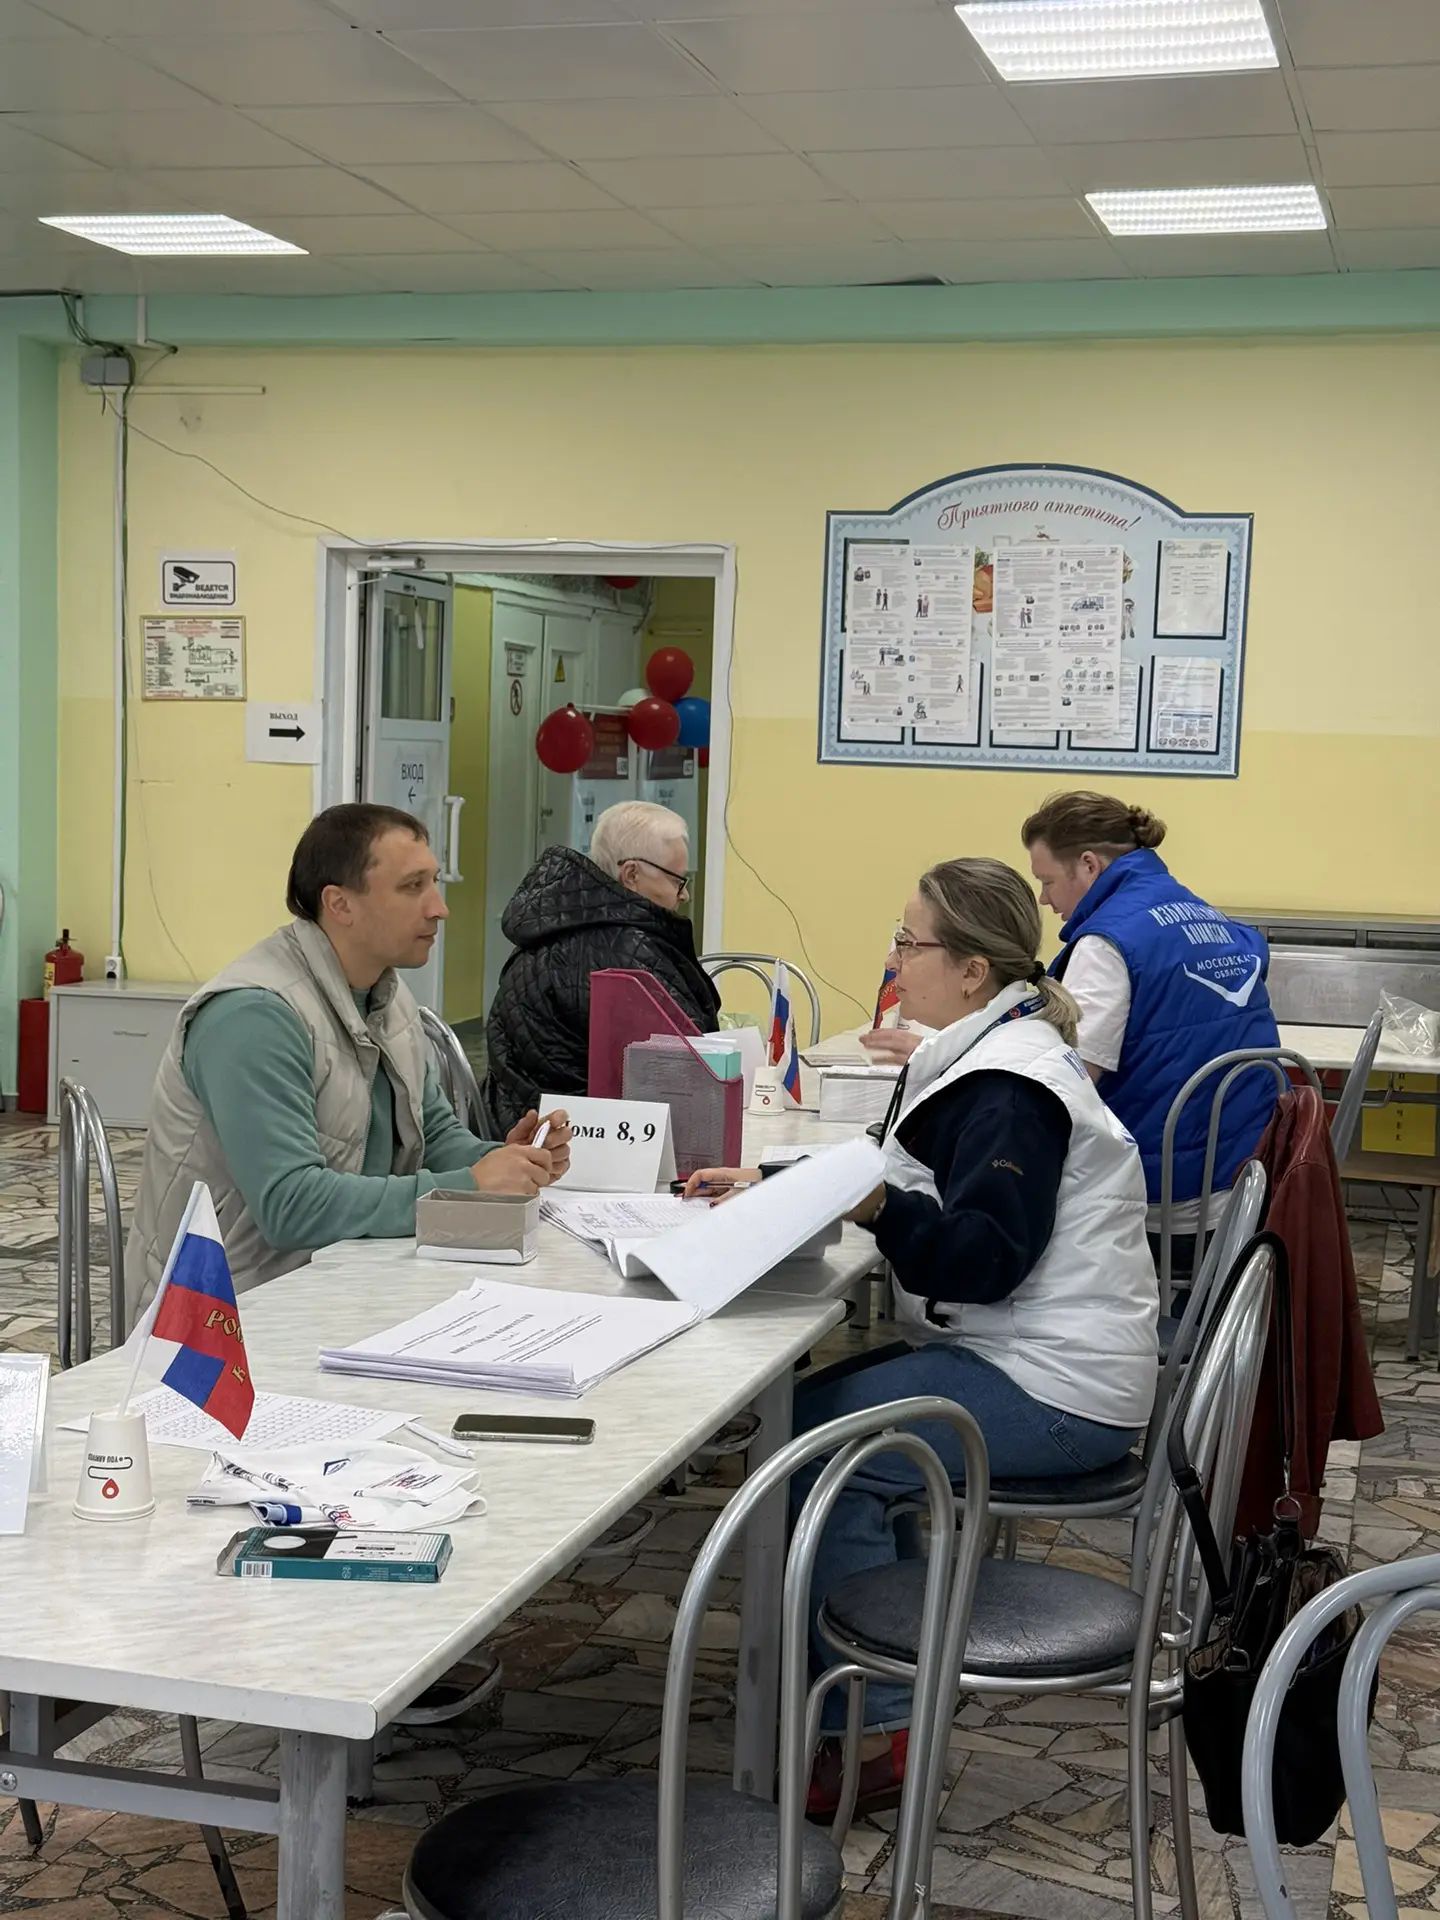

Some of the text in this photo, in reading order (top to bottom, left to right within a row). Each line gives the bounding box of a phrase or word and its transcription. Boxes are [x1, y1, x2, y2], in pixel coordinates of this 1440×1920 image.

[937, 500, 1142, 532] Приятного аппетита!
[169, 592, 229, 600] ВИДЕОНАБЛЮДЕНИЕ
[195, 584, 229, 592] ВЕДЕТСЯ
[401, 763, 424, 784] ВХОД
[1214, 968, 1248, 979] ОБЛАСТЬ
[565, 1120, 656, 1145] ома 8, 9
